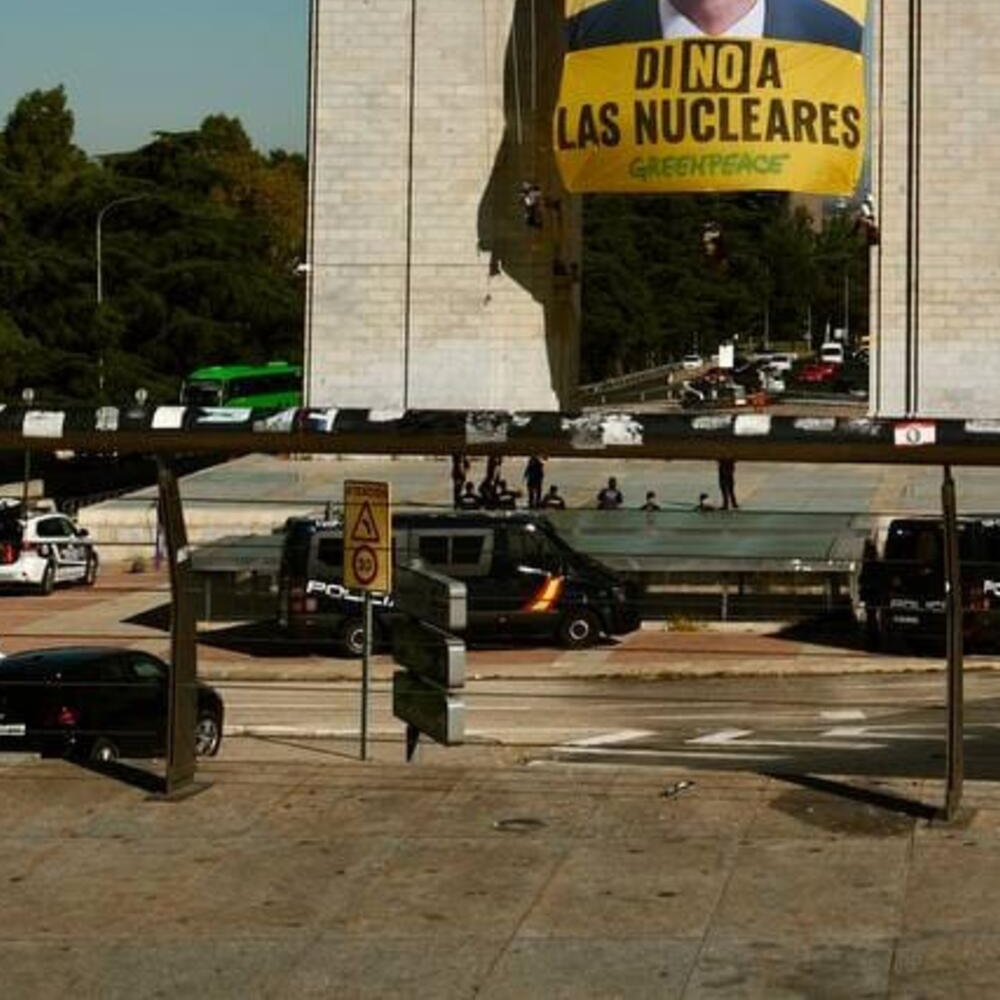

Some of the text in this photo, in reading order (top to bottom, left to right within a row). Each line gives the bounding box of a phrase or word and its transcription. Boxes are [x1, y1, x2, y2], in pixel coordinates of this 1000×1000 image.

[635, 44, 782, 90] DI NO A
[557, 98, 861, 150] LAS NUCLEARES
[629, 154, 790, 182] GREENPEACE
